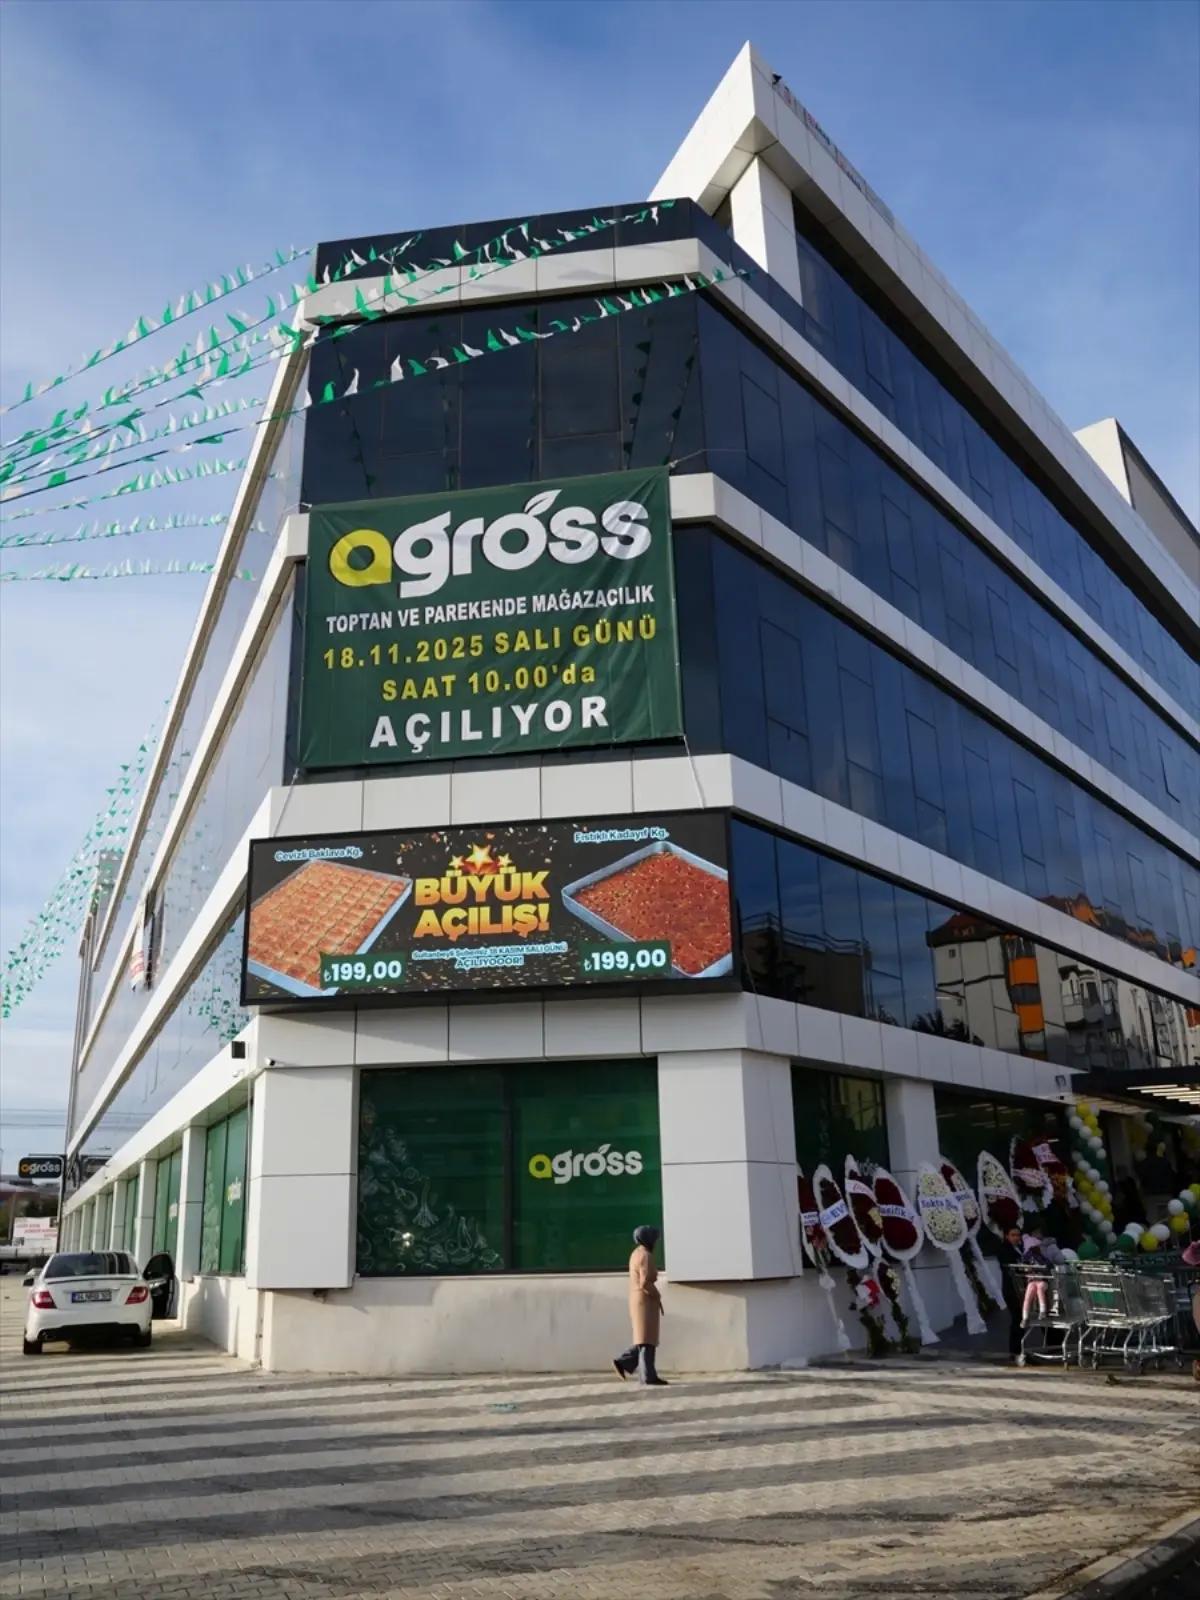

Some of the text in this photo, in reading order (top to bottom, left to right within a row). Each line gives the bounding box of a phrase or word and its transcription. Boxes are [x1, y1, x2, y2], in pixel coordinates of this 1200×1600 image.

[329, 489, 652, 598] agross
[326, 584, 655, 634] TOPTAN VE PAREKENDE MAĞAZACILIK
[324, 615, 656, 670] 18.11.2025 SALI GÜNÜ
[382, 663, 596, 701] SAAT 10.00'da
[369, 695, 609, 753] AÇILIYOR
[308, 847, 345, 859] Baklava
[608, 827, 648, 841] Kadayıf
[414, 866, 550, 906] BÜYÜK
[412, 903, 550, 941] AÇILIŞ!
[498, 945, 524, 955] KASIM
[525, 944, 543, 954] SALI
[20, 1161, 60, 1174] agross
[528, 1143, 643, 1184] agross
